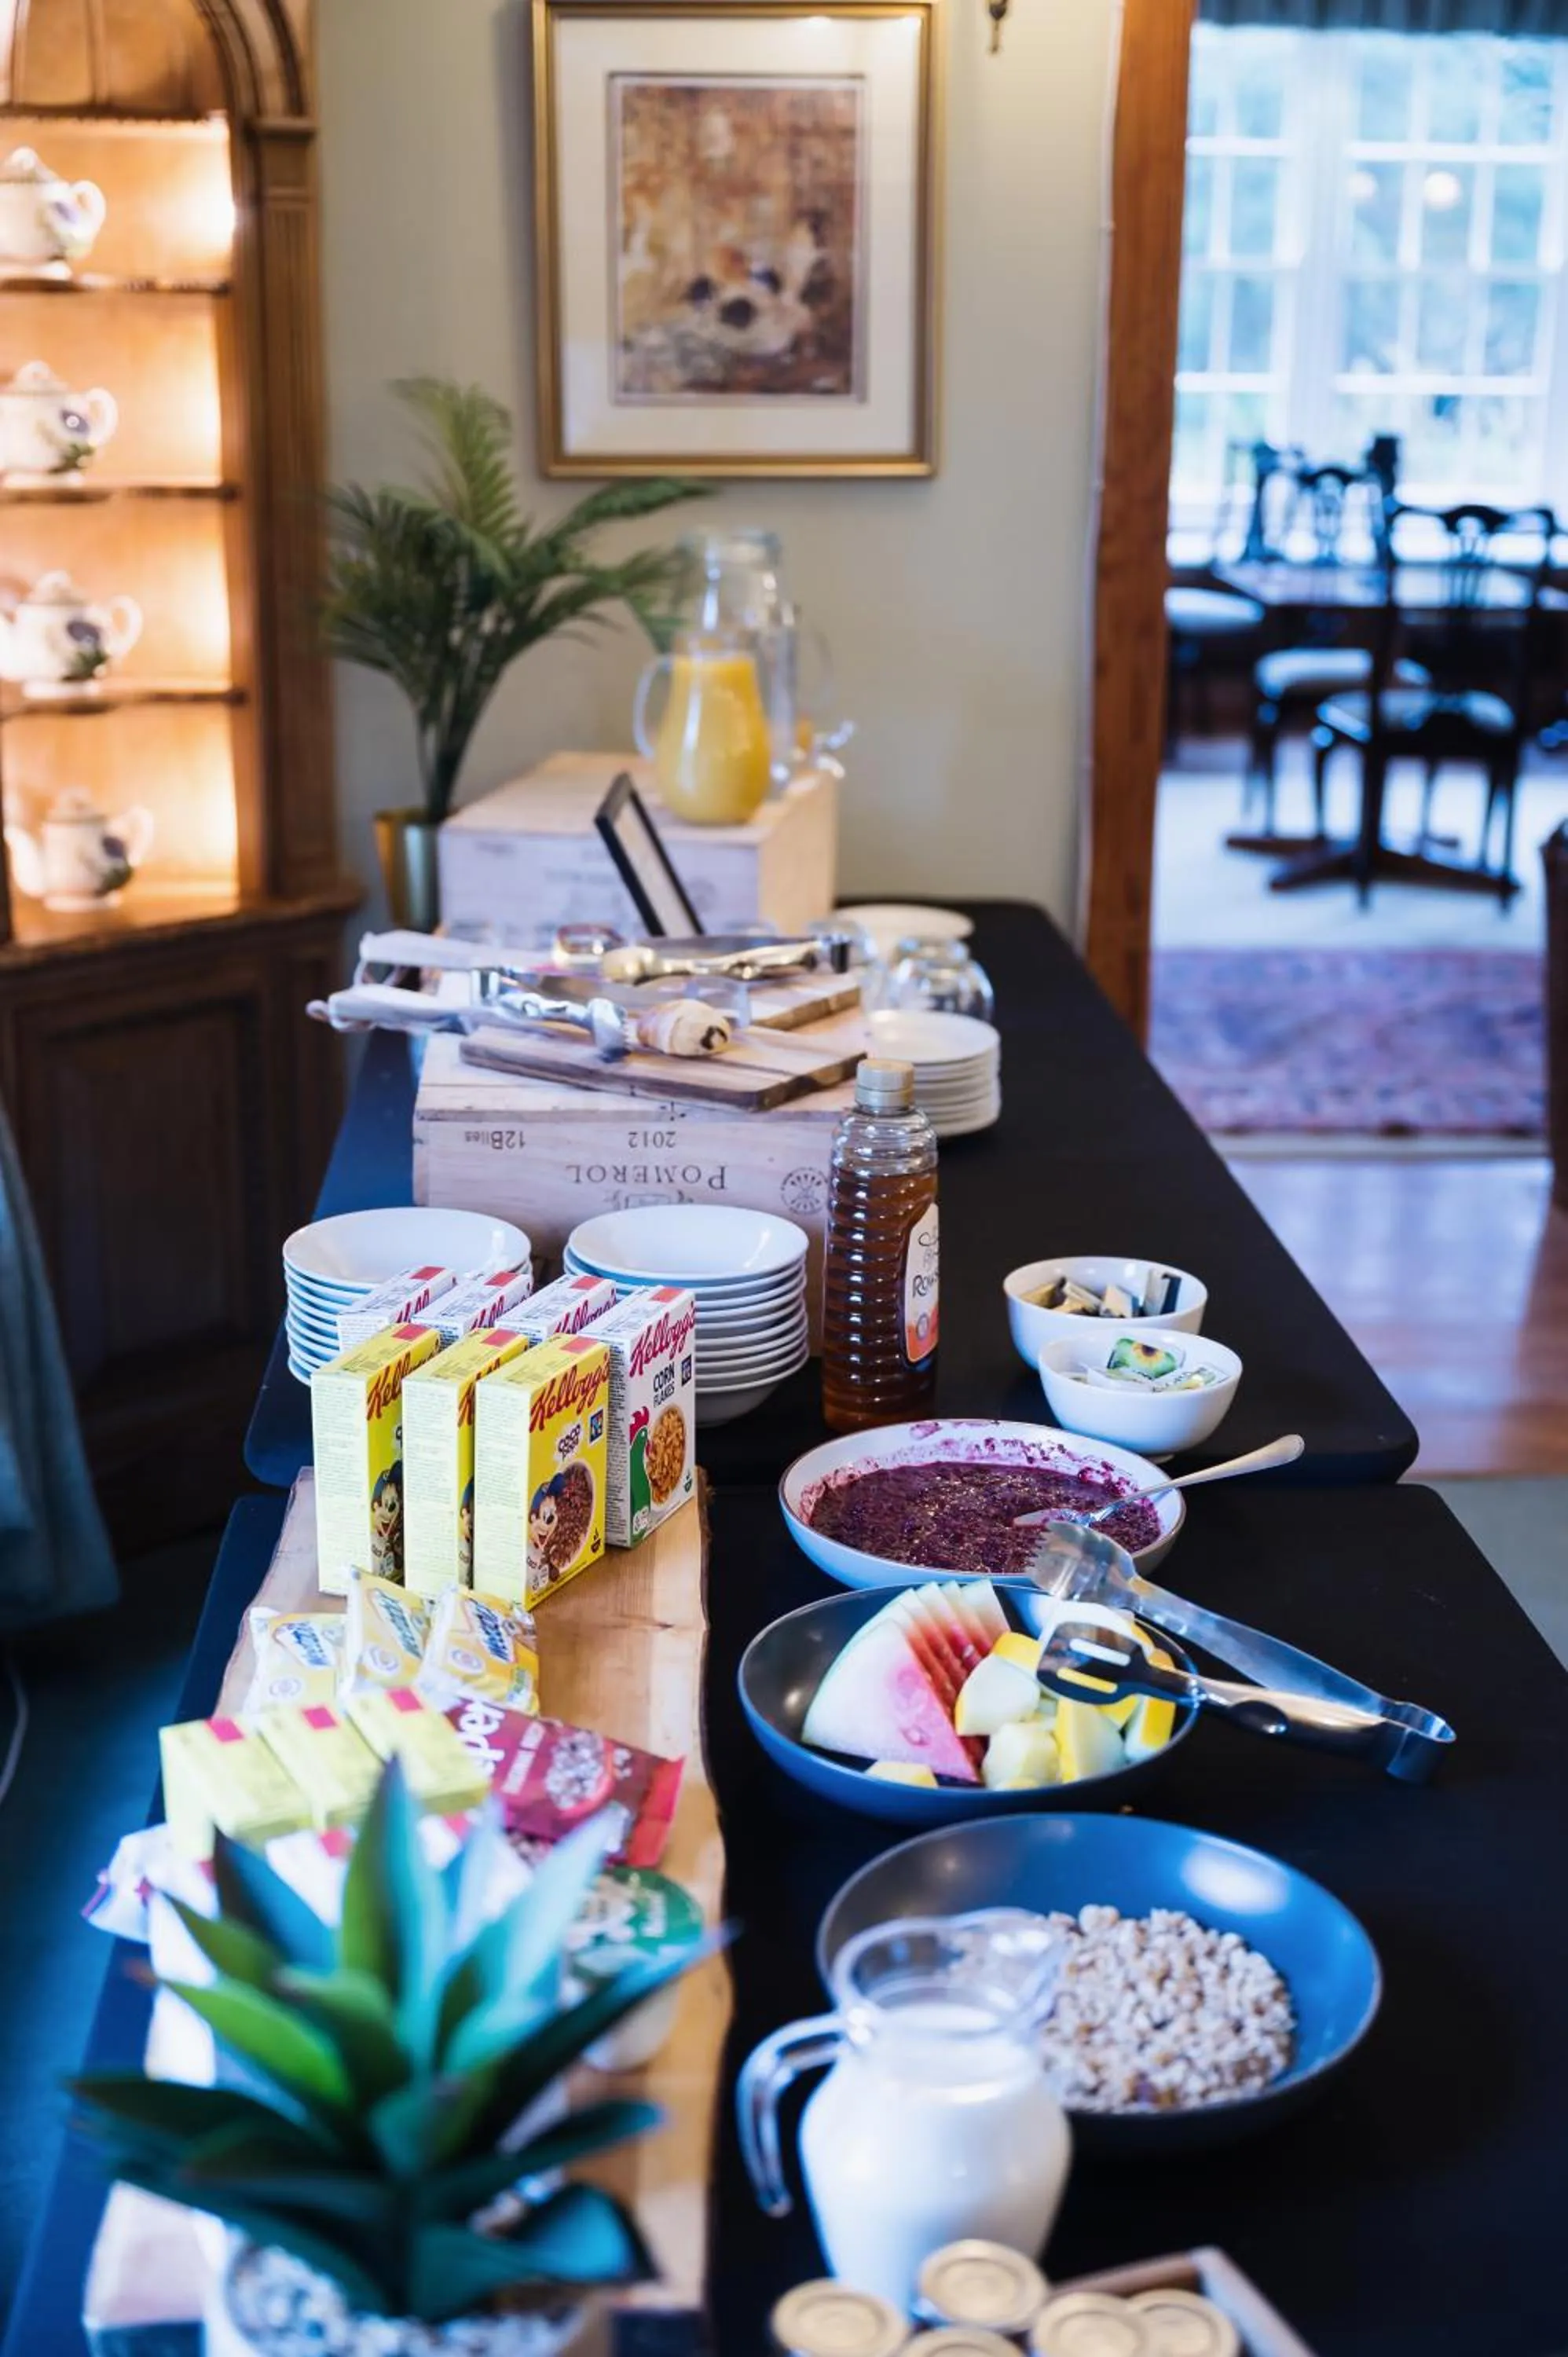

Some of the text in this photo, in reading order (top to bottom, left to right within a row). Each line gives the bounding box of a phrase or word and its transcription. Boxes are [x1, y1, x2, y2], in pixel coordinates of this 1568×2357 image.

[628, 1131, 676, 1148] 2012
[565, 1164, 729, 1189] POMEROL
[629, 1300, 695, 1378] Kellogg's
[529, 1352, 610, 1434] Kellogg's
[653, 1361, 675, 1393] CORN
